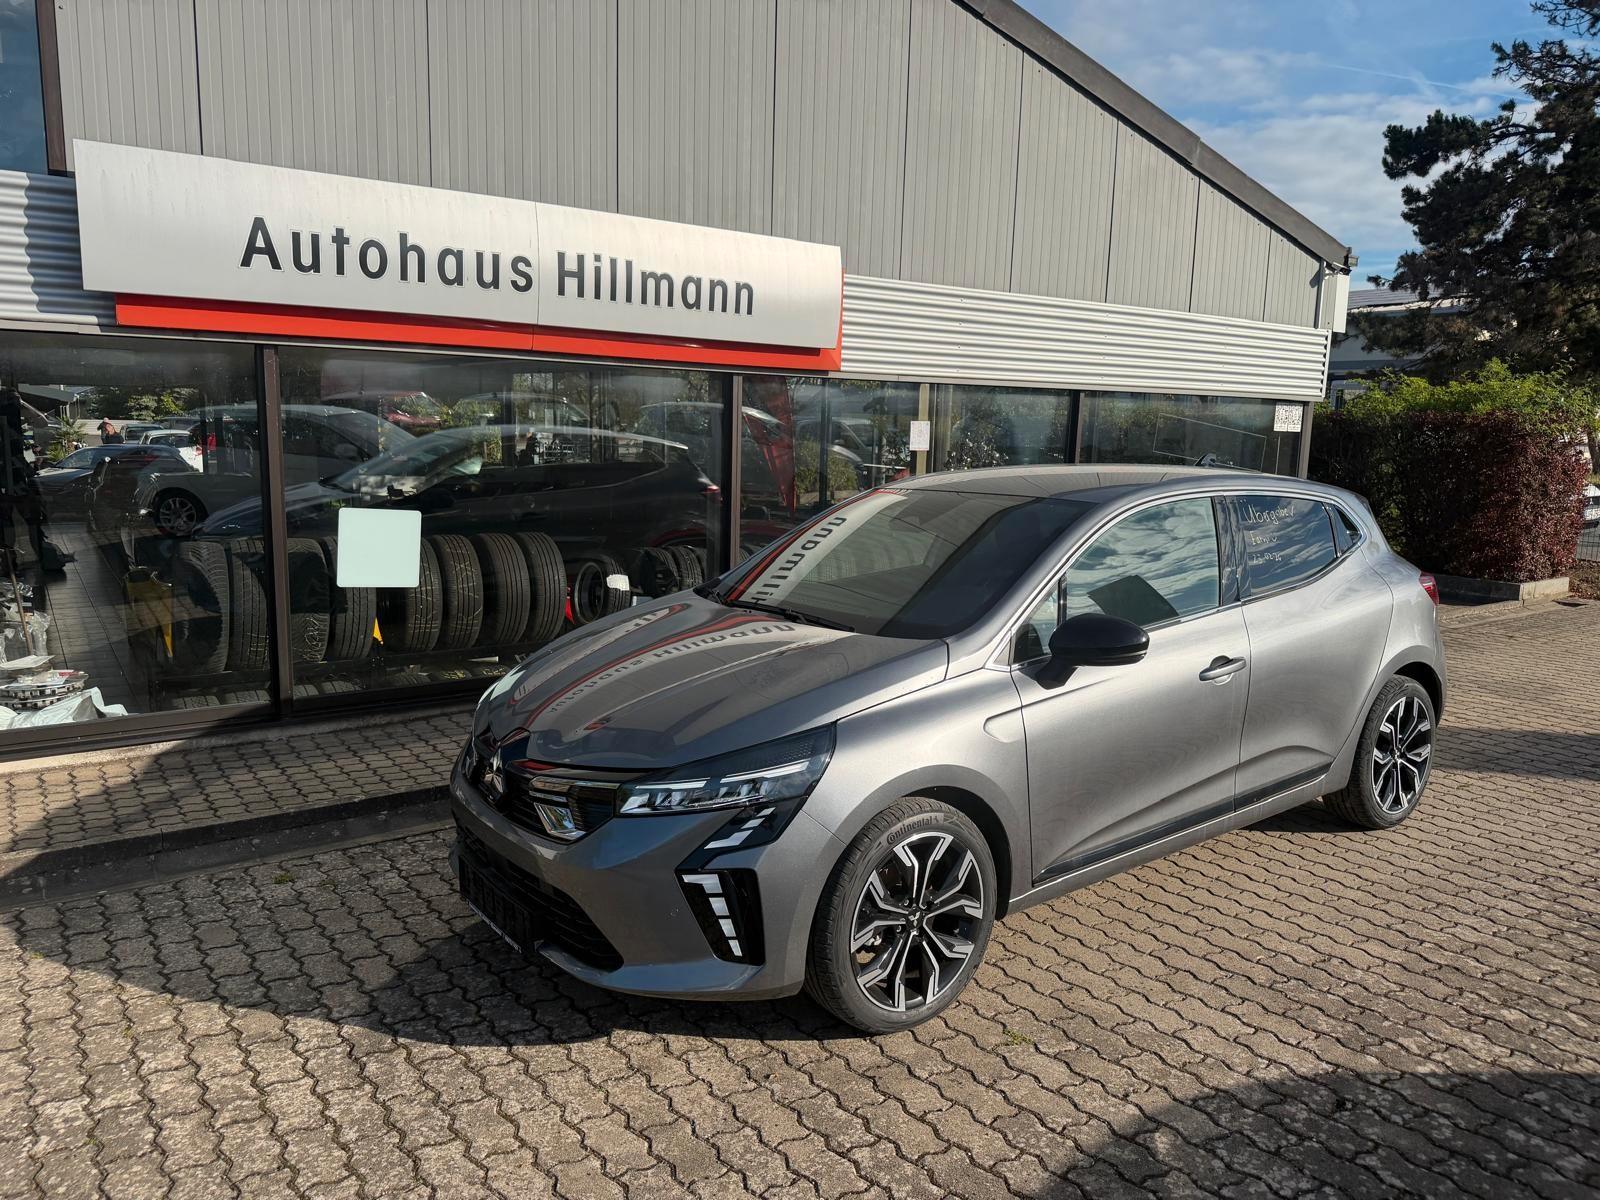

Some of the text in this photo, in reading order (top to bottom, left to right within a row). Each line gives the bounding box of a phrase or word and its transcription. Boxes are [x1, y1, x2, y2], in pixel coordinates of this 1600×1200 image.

[240, 217, 754, 316] Autohaus Hillmann
[887, 816, 933, 845] Continental
